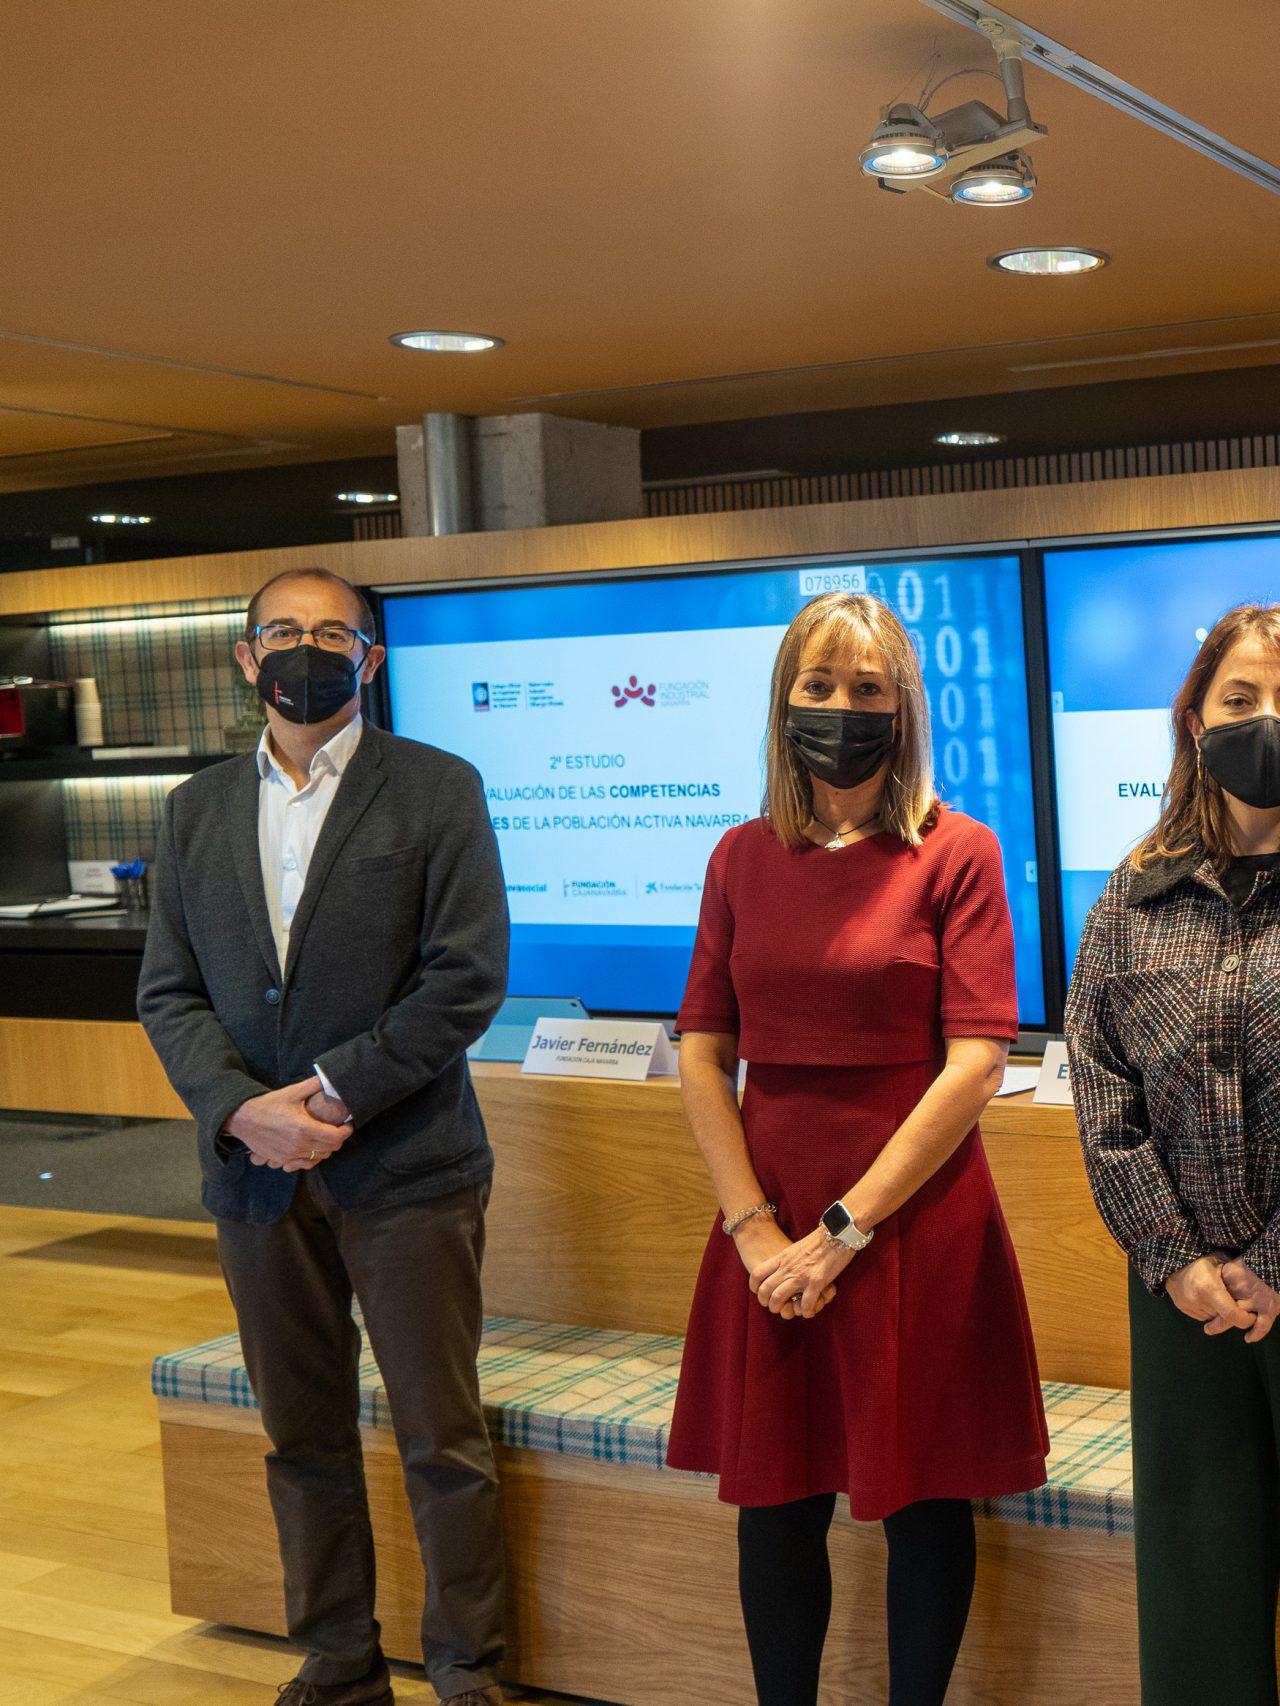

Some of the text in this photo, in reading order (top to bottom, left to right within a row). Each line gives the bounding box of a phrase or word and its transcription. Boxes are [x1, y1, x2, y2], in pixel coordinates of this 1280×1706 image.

[804, 573, 861, 592] 078956
[566, 754, 625, 768] ESTUDIO
[559, 786, 577, 800] DE
[581, 785, 605, 799] LAS
[610, 783, 720, 798] COMPETENCIAS
[513, 816, 530, 830] DE
[535, 815, 550, 829] LA
[553, 812, 630, 829] POBLACIÓN
[634, 814, 682, 828] ACTIVA
[532, 1035, 653, 1056] Javier Fernández
